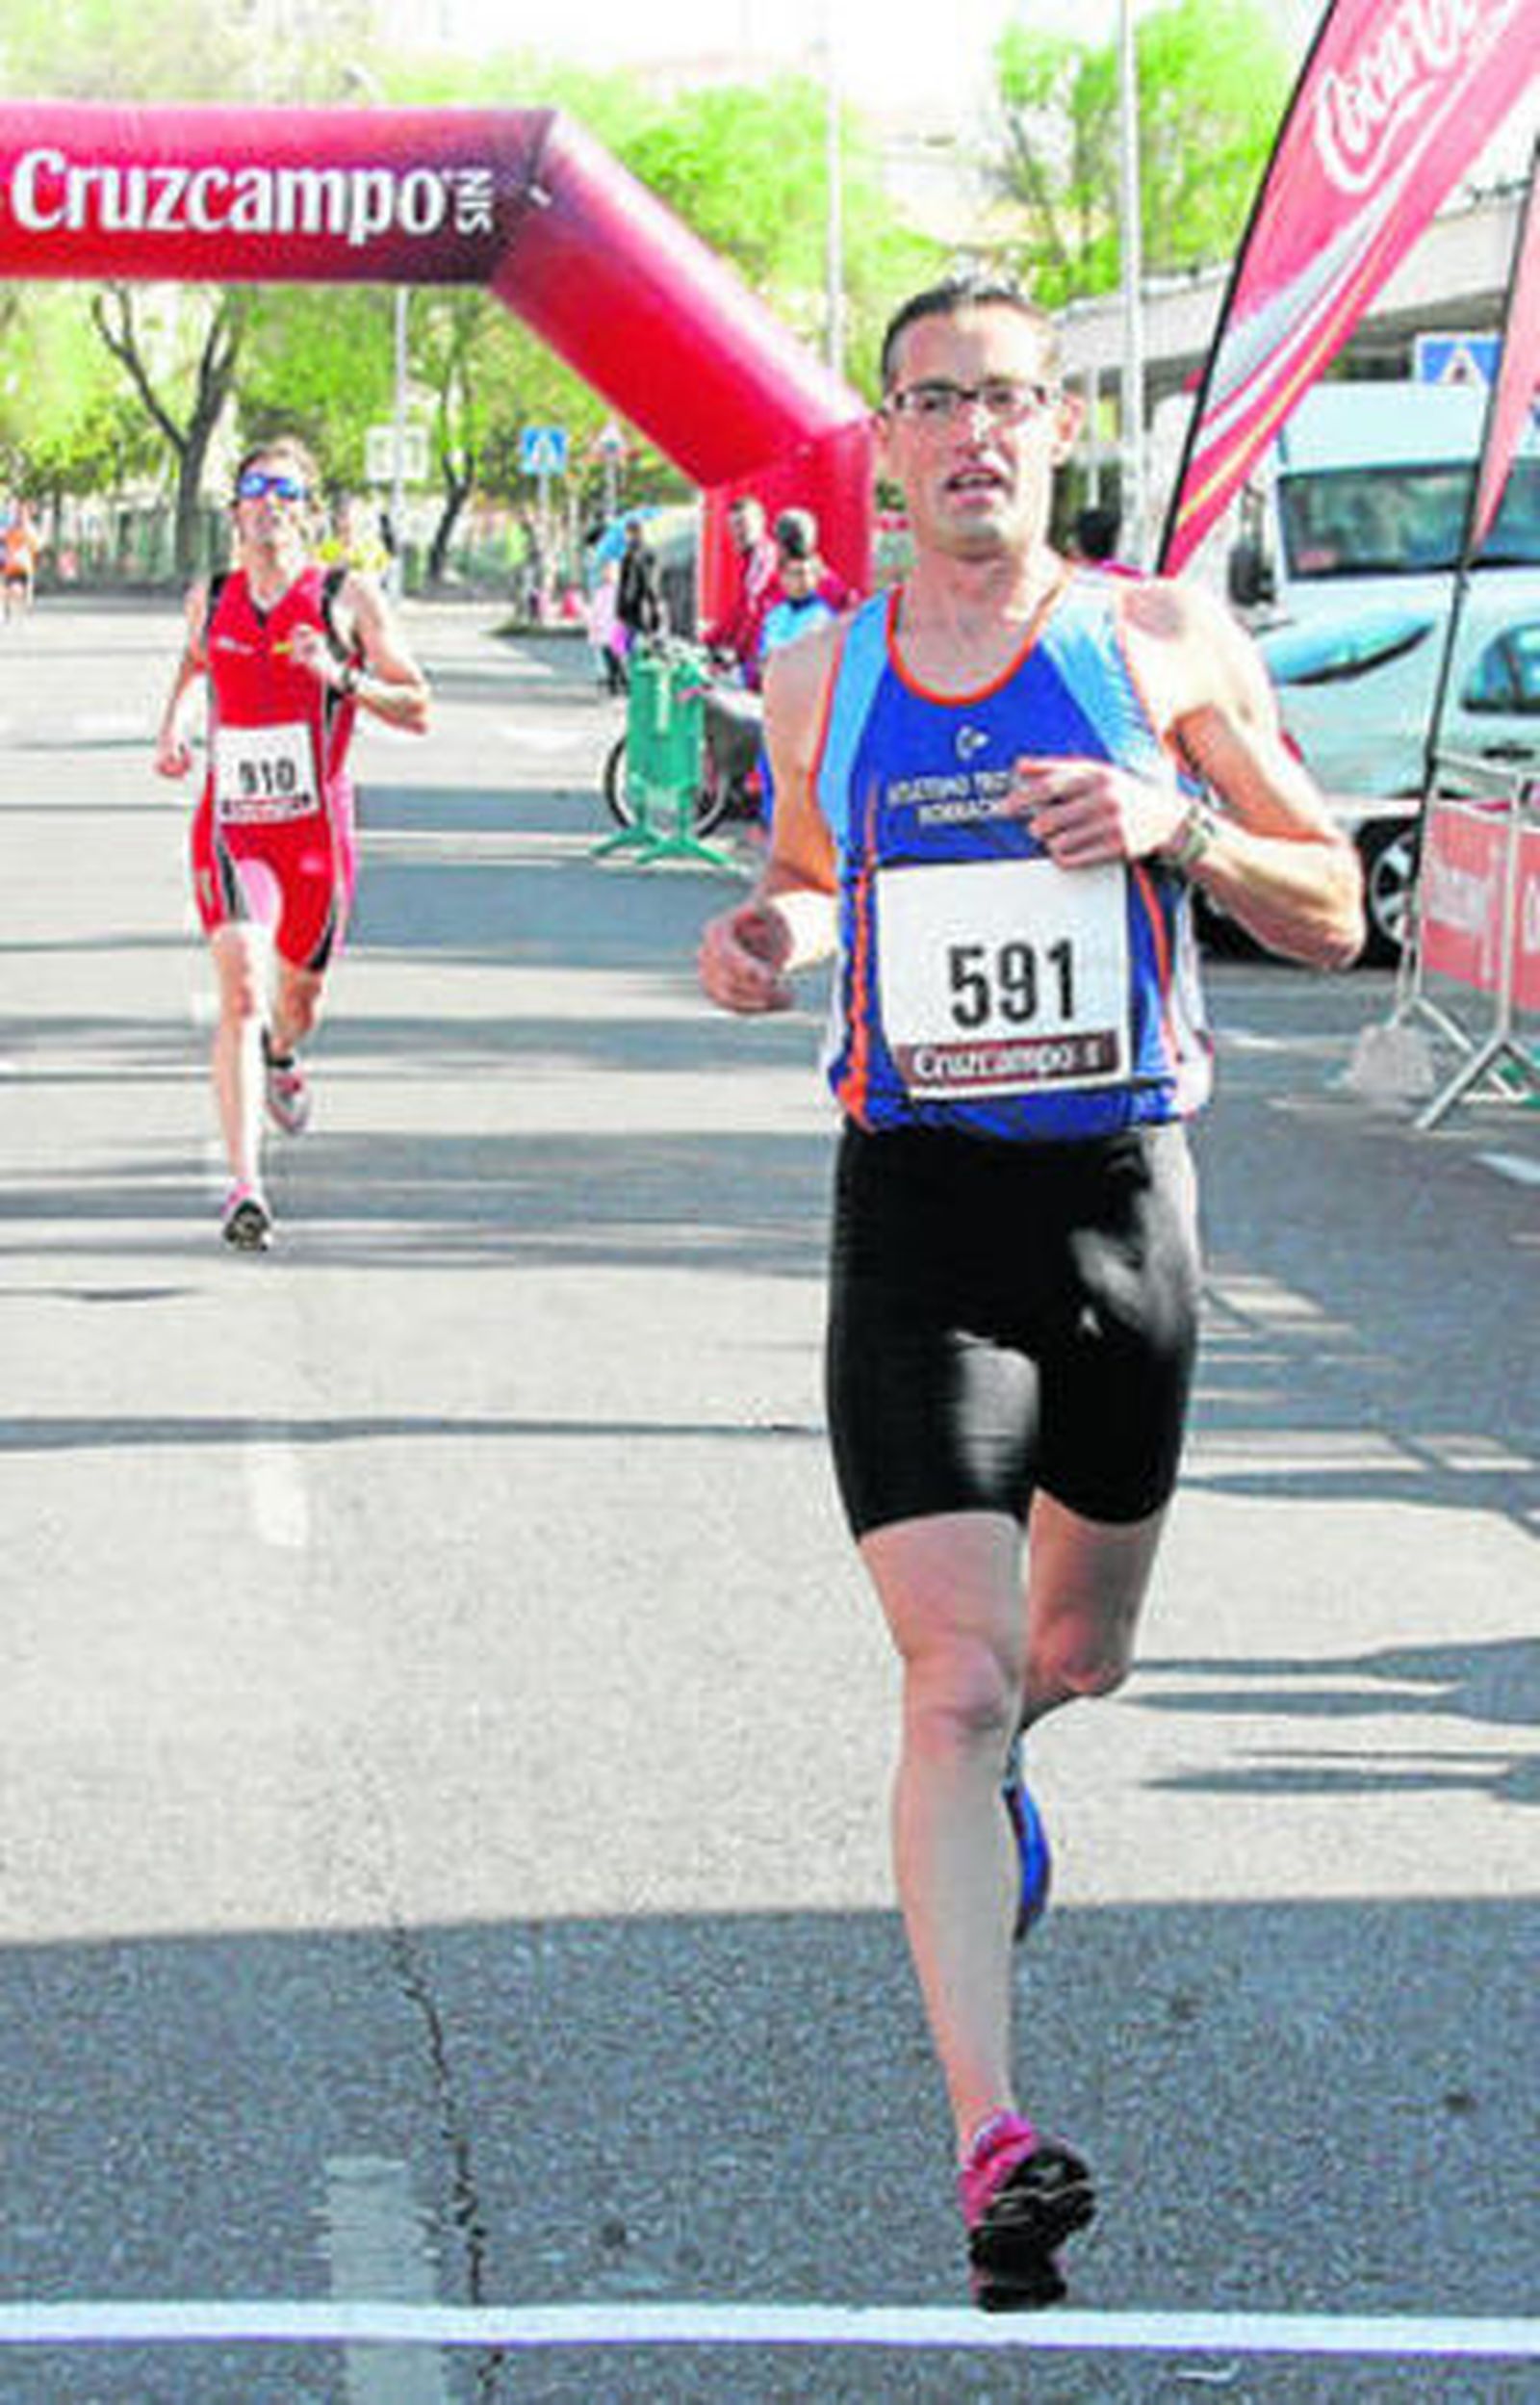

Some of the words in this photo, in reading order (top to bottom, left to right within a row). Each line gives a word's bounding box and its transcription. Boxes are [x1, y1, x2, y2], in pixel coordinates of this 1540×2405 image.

[11, 148, 446, 246] Cruzcampo
[454, 169, 494, 234] SIN
[948, 938, 1074, 1028] 591
